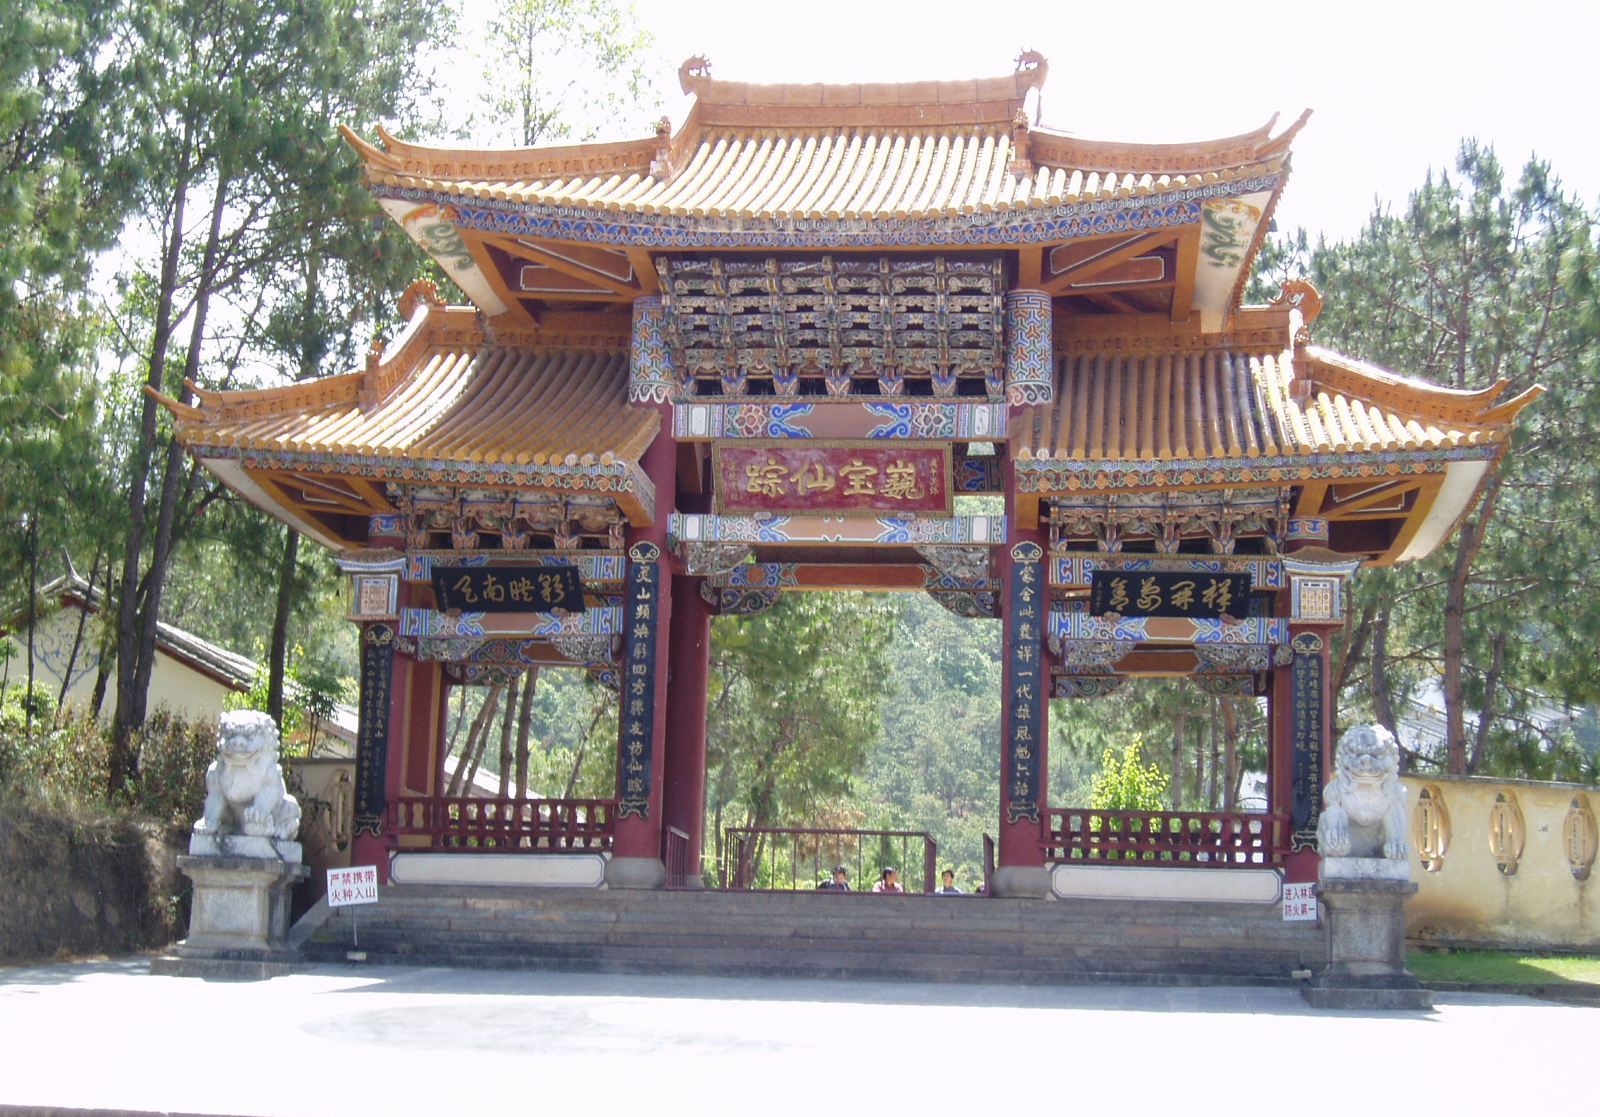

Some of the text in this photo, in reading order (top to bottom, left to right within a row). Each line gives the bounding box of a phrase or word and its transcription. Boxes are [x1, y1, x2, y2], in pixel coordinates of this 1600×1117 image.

[330, 870, 375, 886] 严禁携带
[331, 887, 376, 903] 火种入山
[1285, 903, 1315, 917] 防火第一
